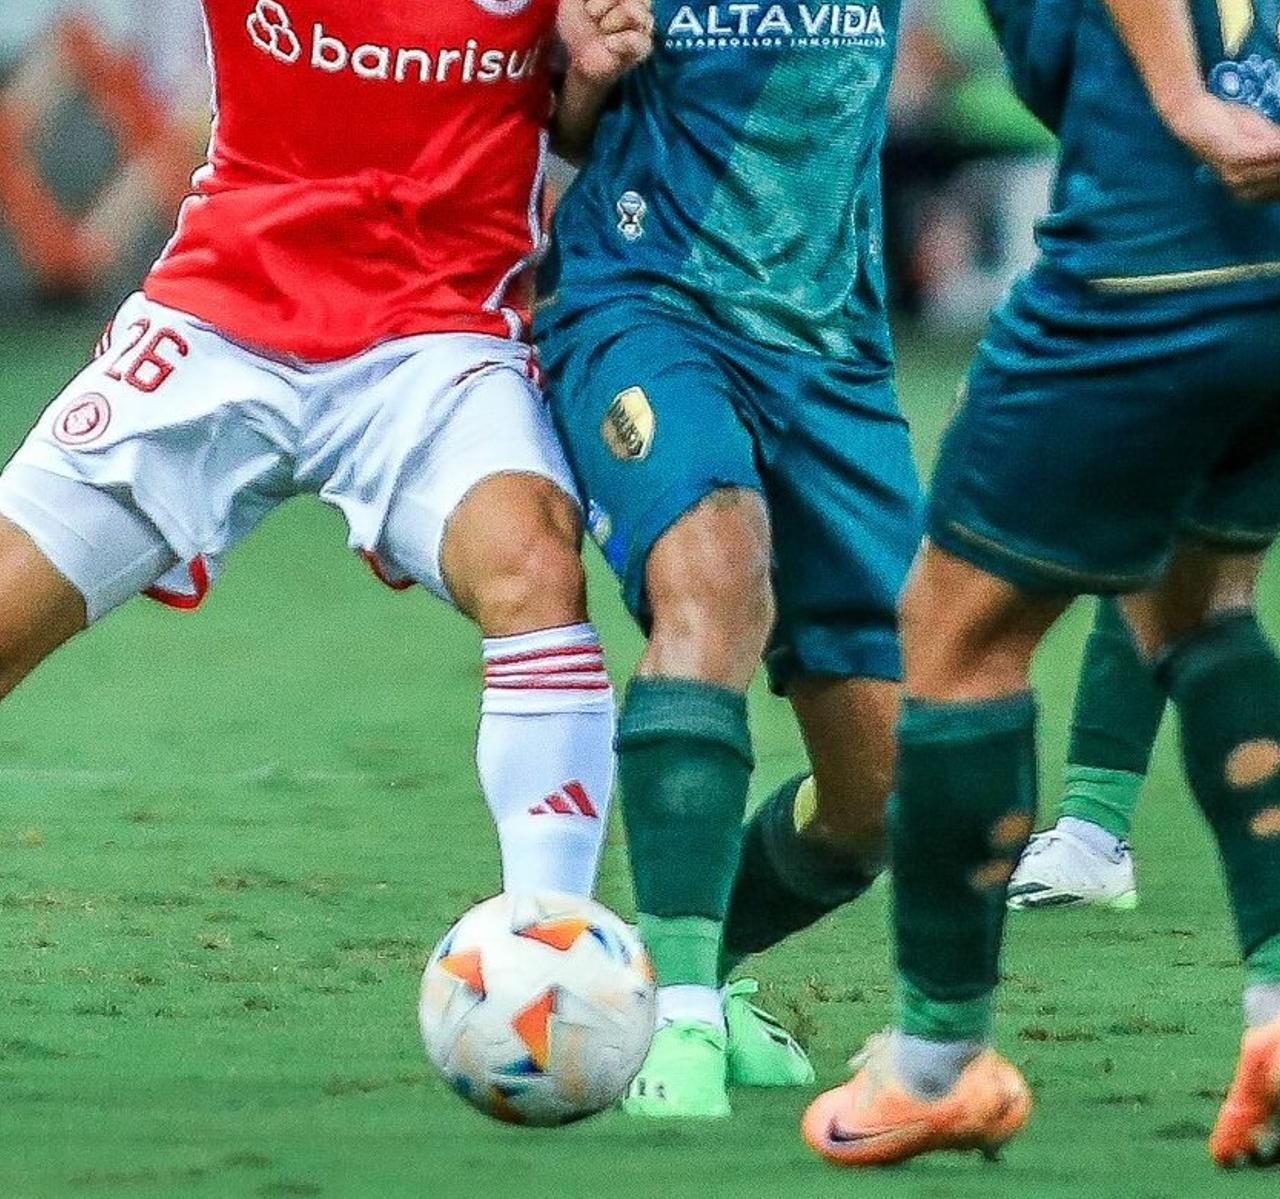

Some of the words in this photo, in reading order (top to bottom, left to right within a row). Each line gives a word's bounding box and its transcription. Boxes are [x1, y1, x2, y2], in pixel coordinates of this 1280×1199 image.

[798, 3, 885, 36] VIDA
[310, 23, 540, 84] banrisu
[104, 318, 190, 393] 26
